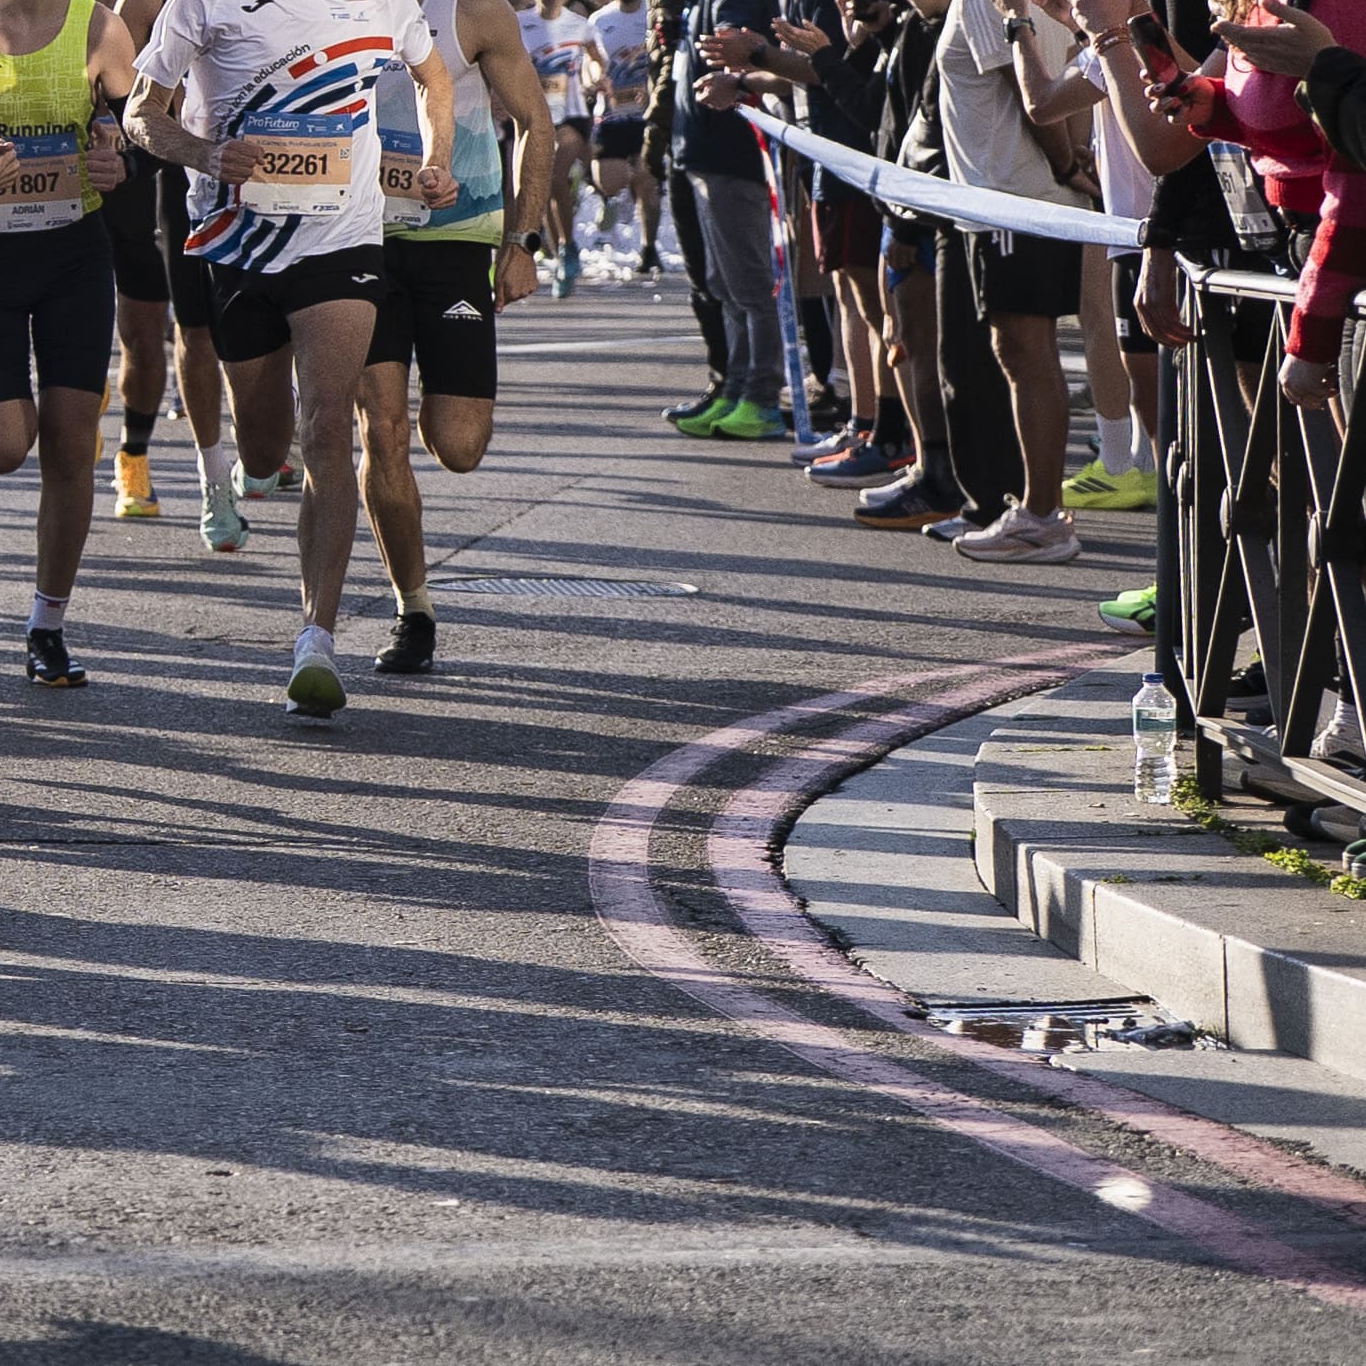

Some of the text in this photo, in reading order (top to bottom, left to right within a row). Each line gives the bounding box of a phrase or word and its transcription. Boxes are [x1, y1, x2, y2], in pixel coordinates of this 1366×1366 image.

[253, 43, 312, 85] educación
[247, 115, 301, 130] ProFuturo
[262, 152, 329, 176] 32261
[11, 204, 45, 216] ADRIÁN
